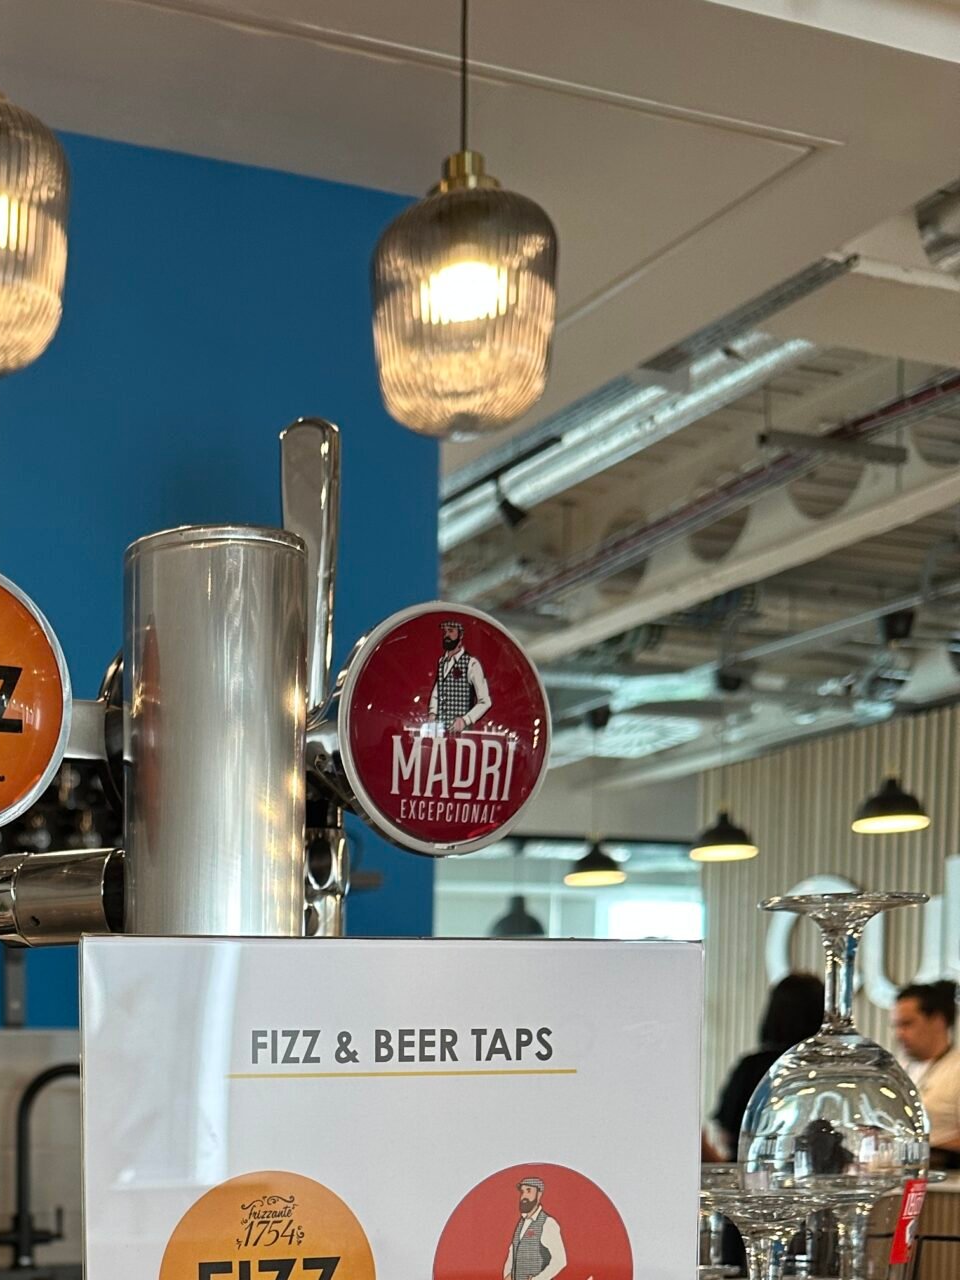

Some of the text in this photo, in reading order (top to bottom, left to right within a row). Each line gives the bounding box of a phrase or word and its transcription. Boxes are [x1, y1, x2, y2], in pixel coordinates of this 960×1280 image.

[250, 1027, 554, 1065] FIZZ & BEER TAPS
[243, 1219, 295, 1248] 1754
